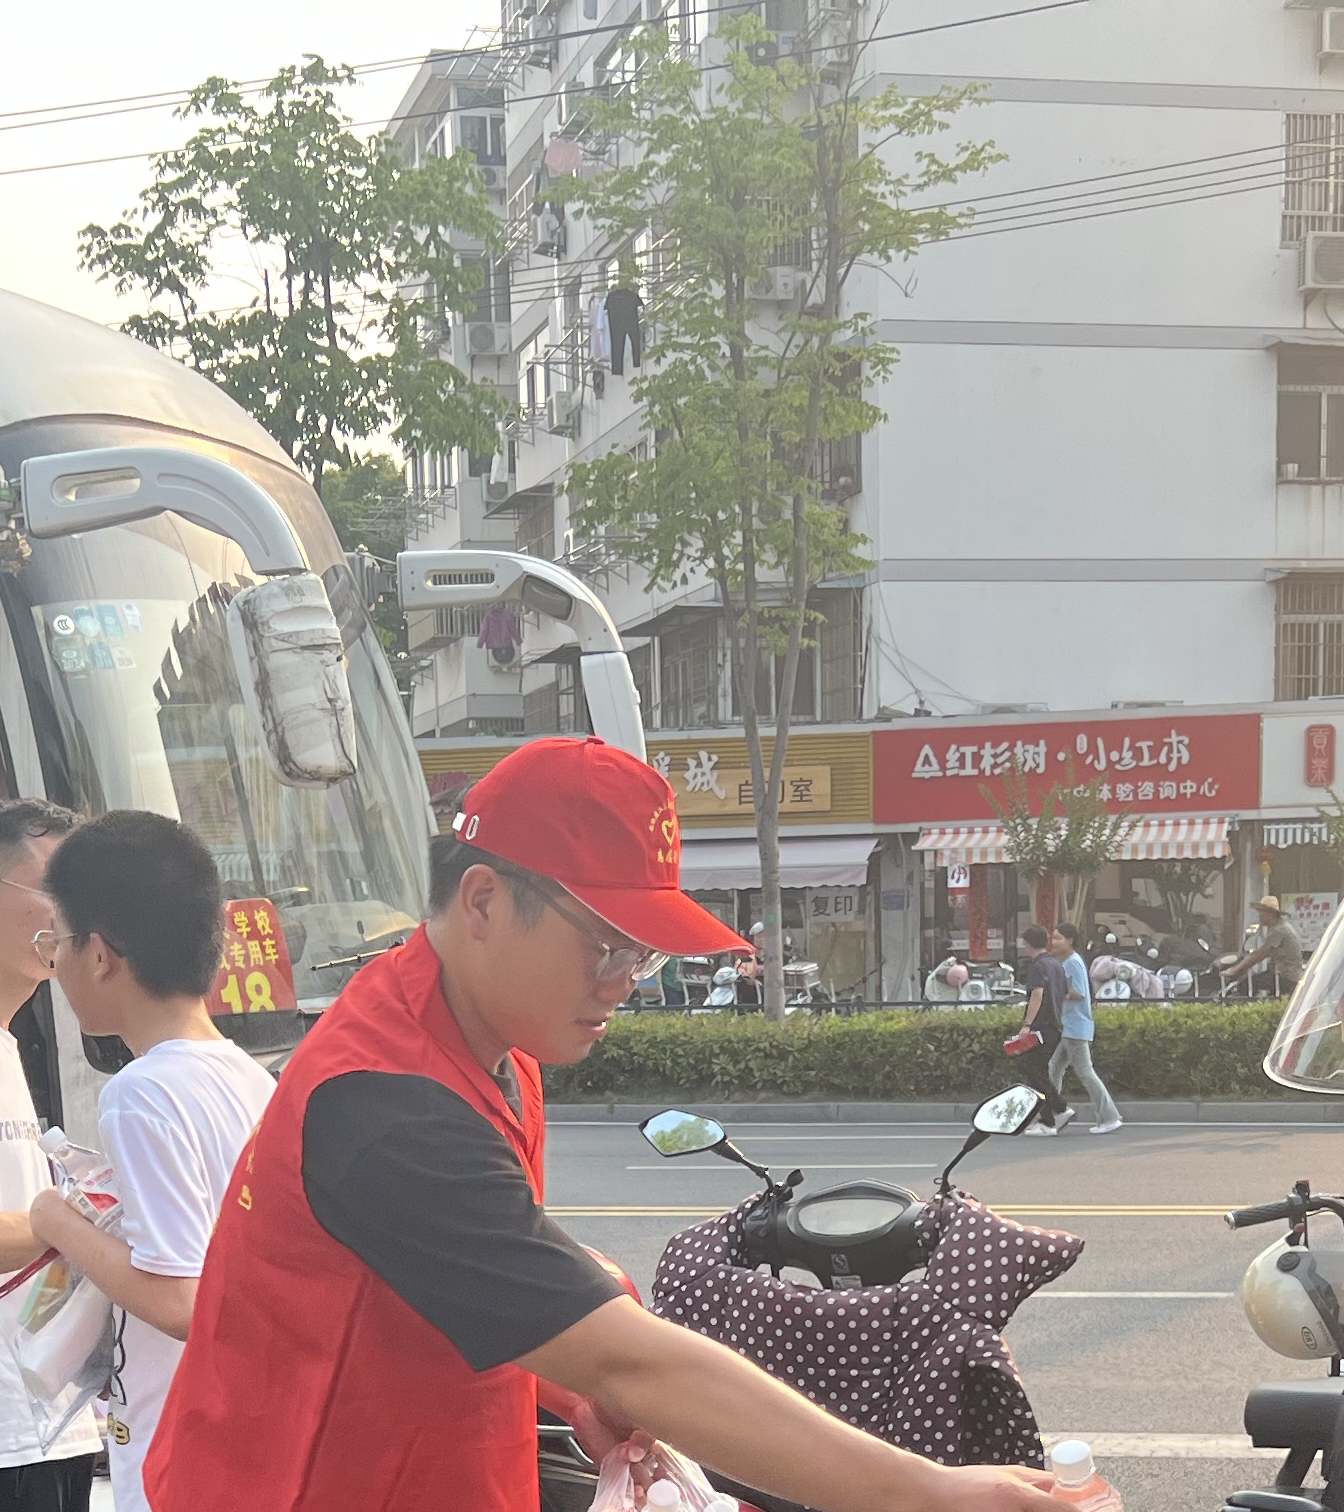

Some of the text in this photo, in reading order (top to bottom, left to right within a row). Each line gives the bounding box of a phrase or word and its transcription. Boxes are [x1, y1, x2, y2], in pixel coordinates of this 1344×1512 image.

[738, 777, 814, 806] 自室
[810, 894, 853, 918] 复印
[220, 971, 276, 1014] 18
